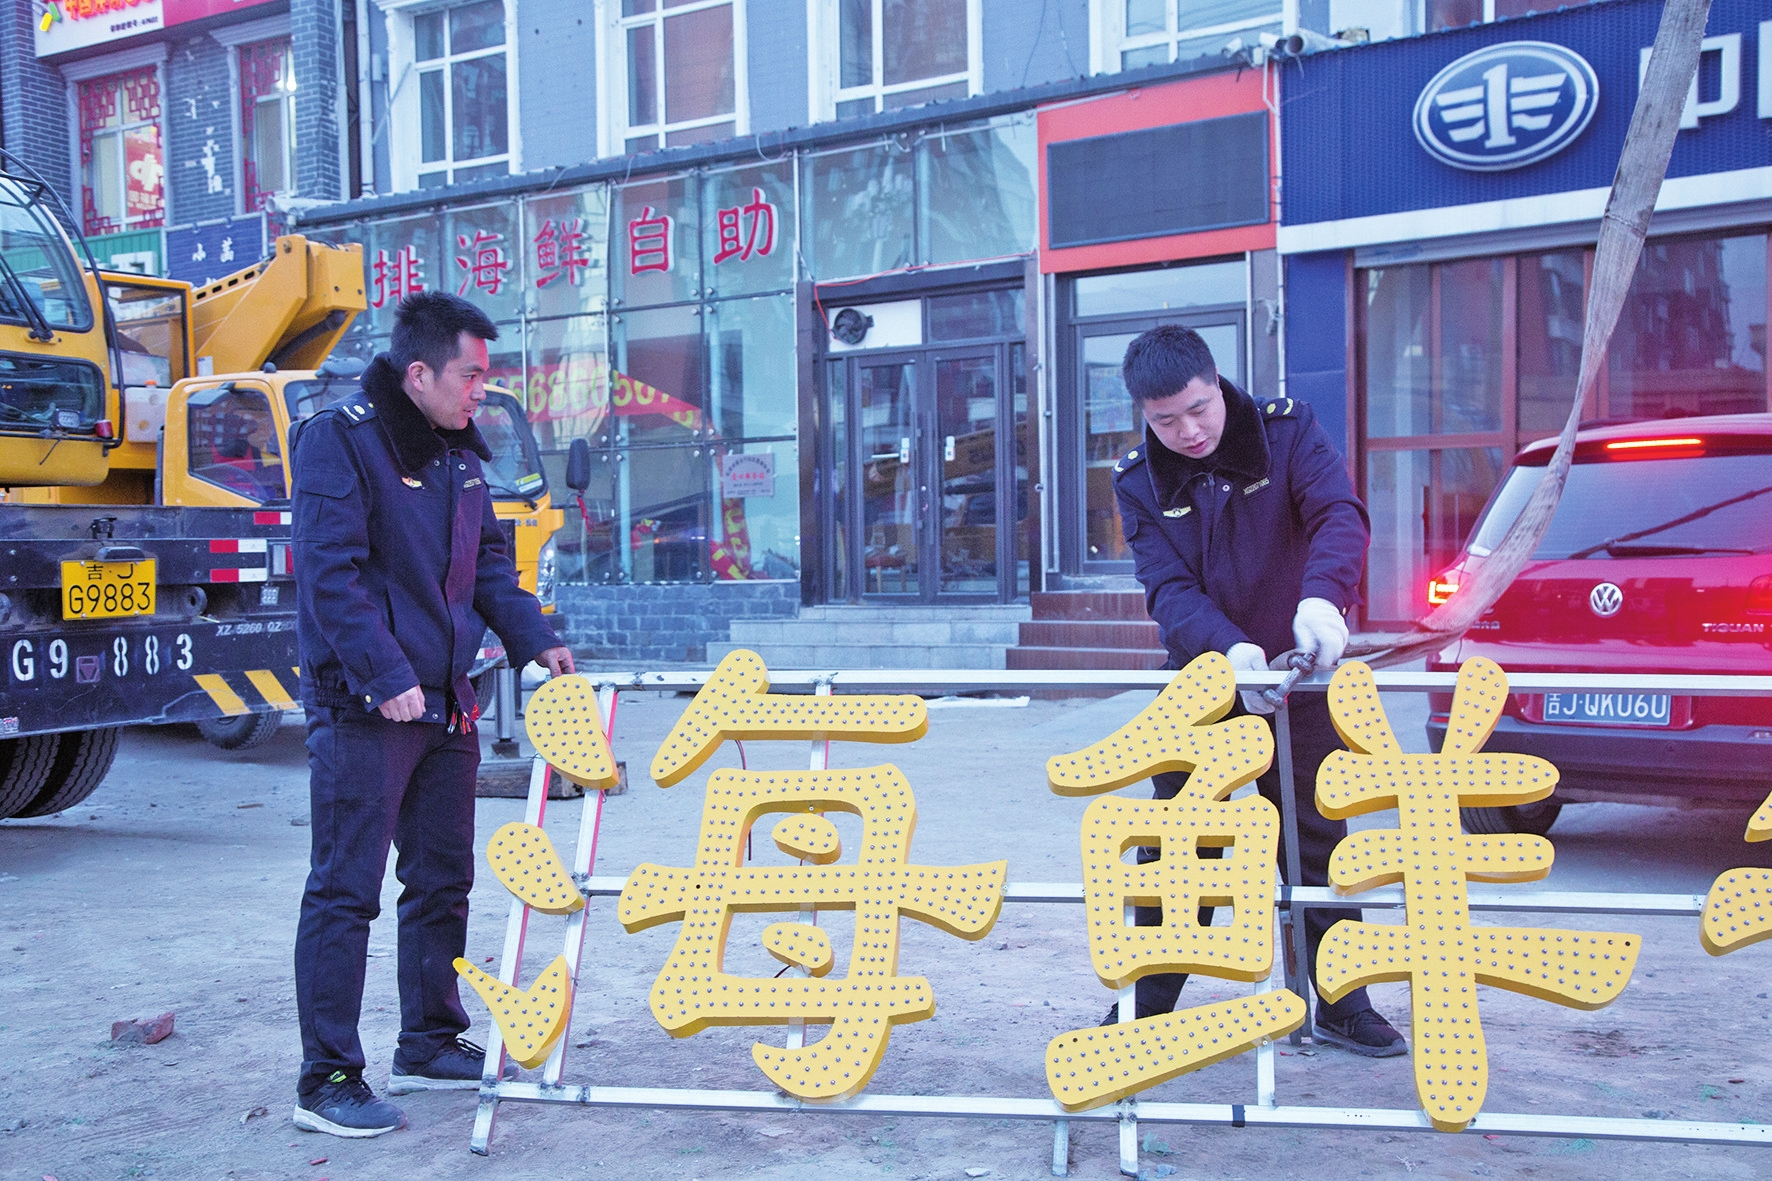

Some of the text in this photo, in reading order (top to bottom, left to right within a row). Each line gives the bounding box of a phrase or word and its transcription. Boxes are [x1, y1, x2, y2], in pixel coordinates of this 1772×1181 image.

[69, 583, 151, 614] G9883
[1701, 622, 1765, 633] TIGUAN
[453, 648, 1772, 1131] 海鲜
